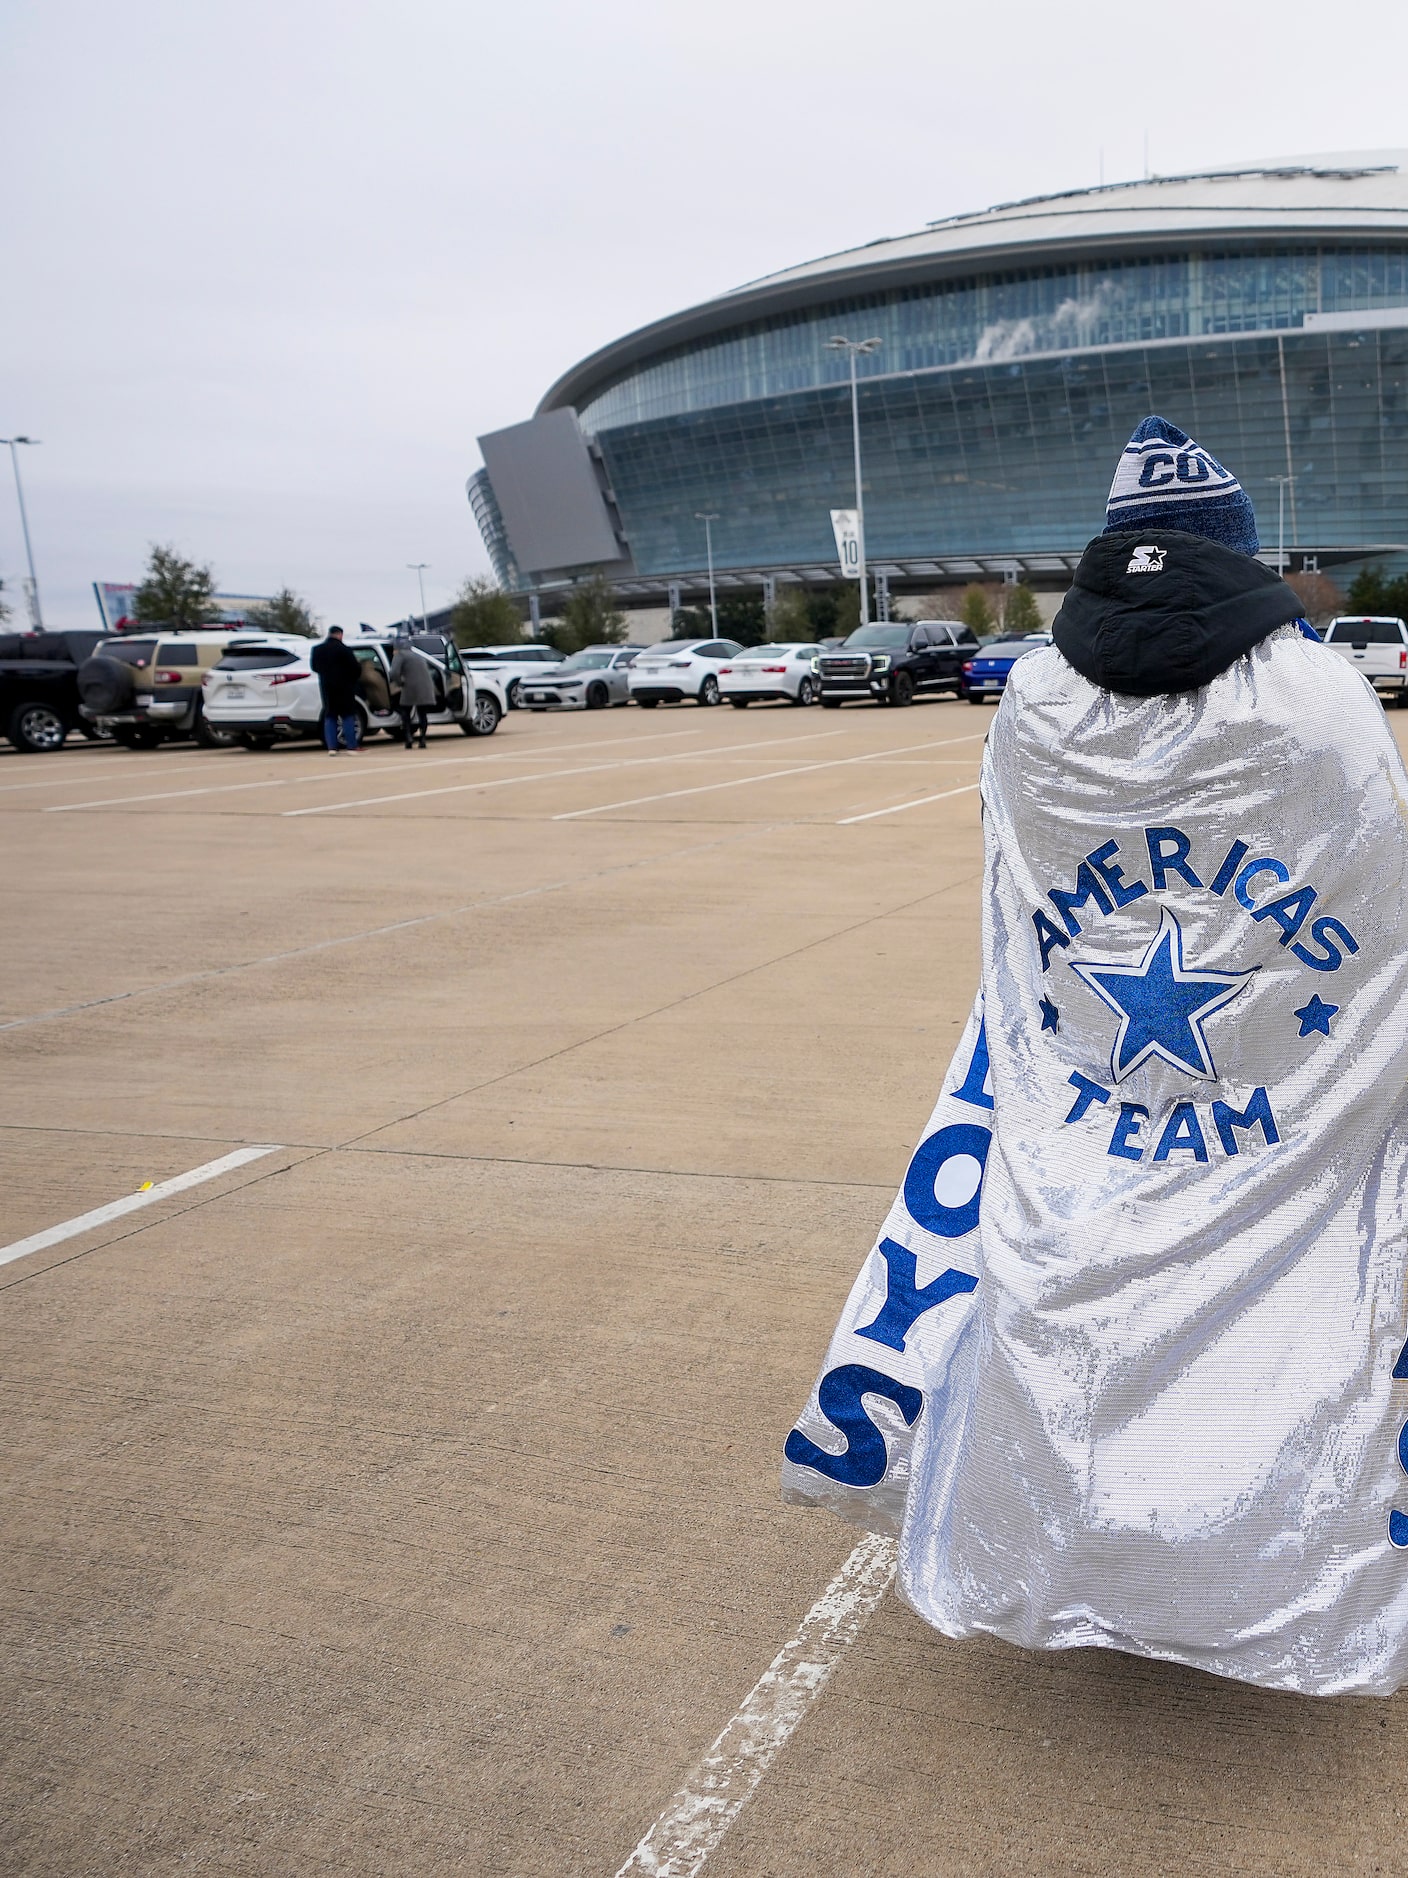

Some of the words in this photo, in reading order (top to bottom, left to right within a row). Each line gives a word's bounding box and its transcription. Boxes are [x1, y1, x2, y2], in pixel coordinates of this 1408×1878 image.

[842, 540, 858, 565] 10
[1126, 565, 1164, 574] STARTER
[1032, 826, 1361, 972] AMERICAS
[1064, 1070, 1282, 1162] TEAM
